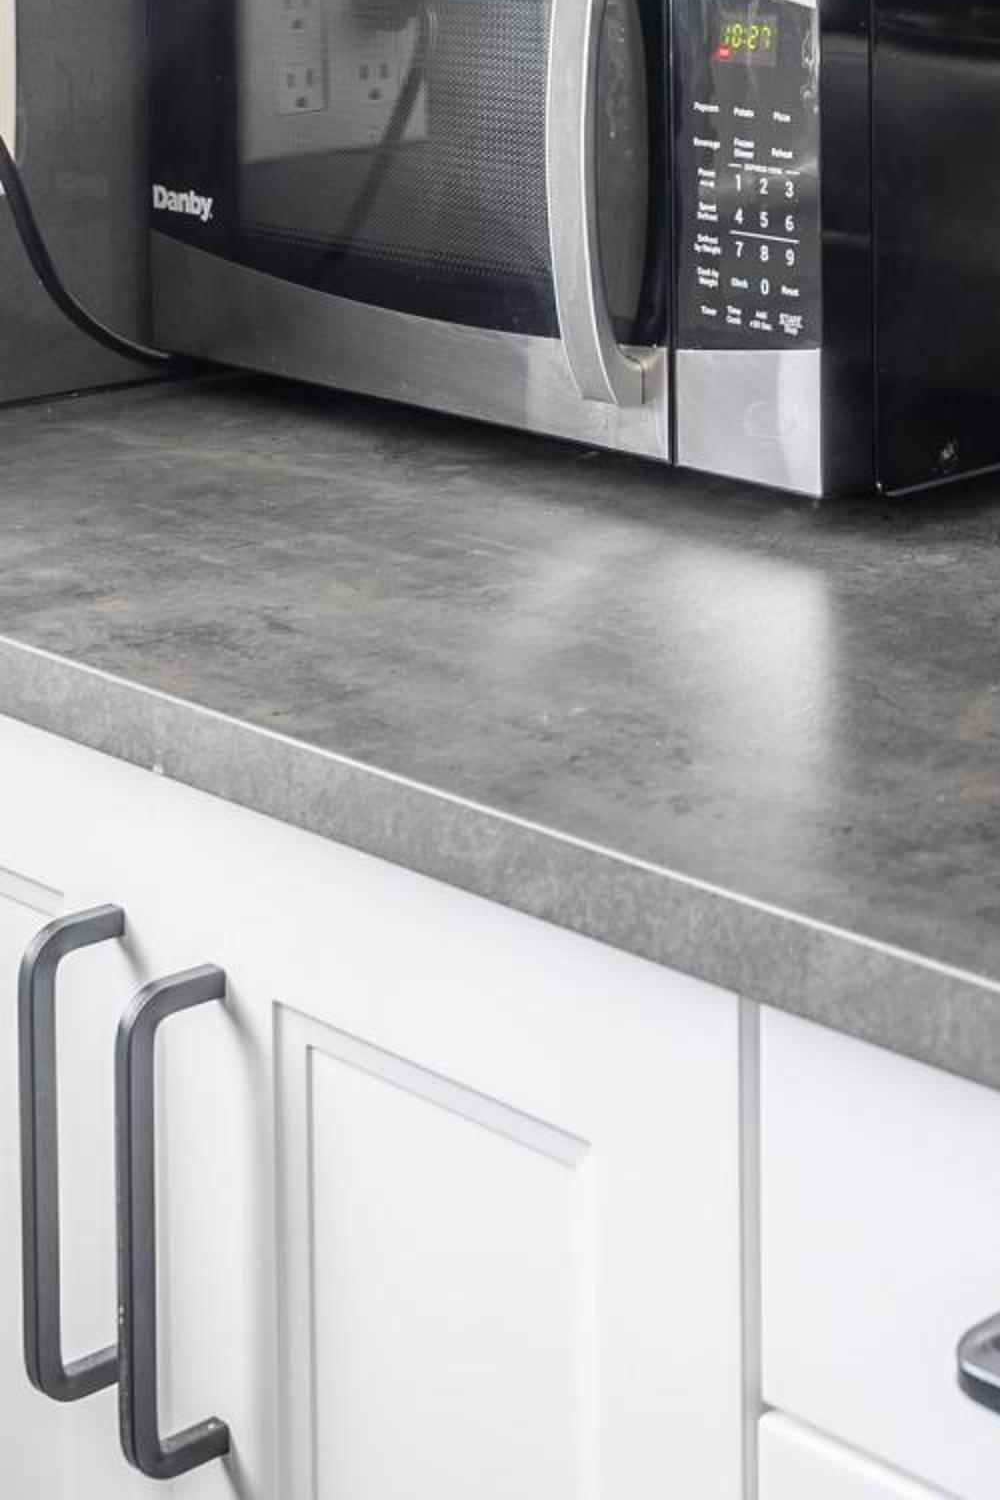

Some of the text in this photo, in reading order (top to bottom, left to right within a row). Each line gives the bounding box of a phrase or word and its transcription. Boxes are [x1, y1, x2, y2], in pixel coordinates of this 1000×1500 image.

[723, 23, 771, 50] 10:27
[735, 173, 741, 192] 1
[760, 177, 769, 195] 2
[785, 181, 795, 198] 3
[152, 184, 213, 222] Danby
[735, 207, 744, 225] 4
[760, 211, 769, 229] 5
[785, 215, 795, 232] 6
[735, 241, 744, 258] 7
[760, 245, 769, 262] 8
[785, 248, 795, 267] 9
